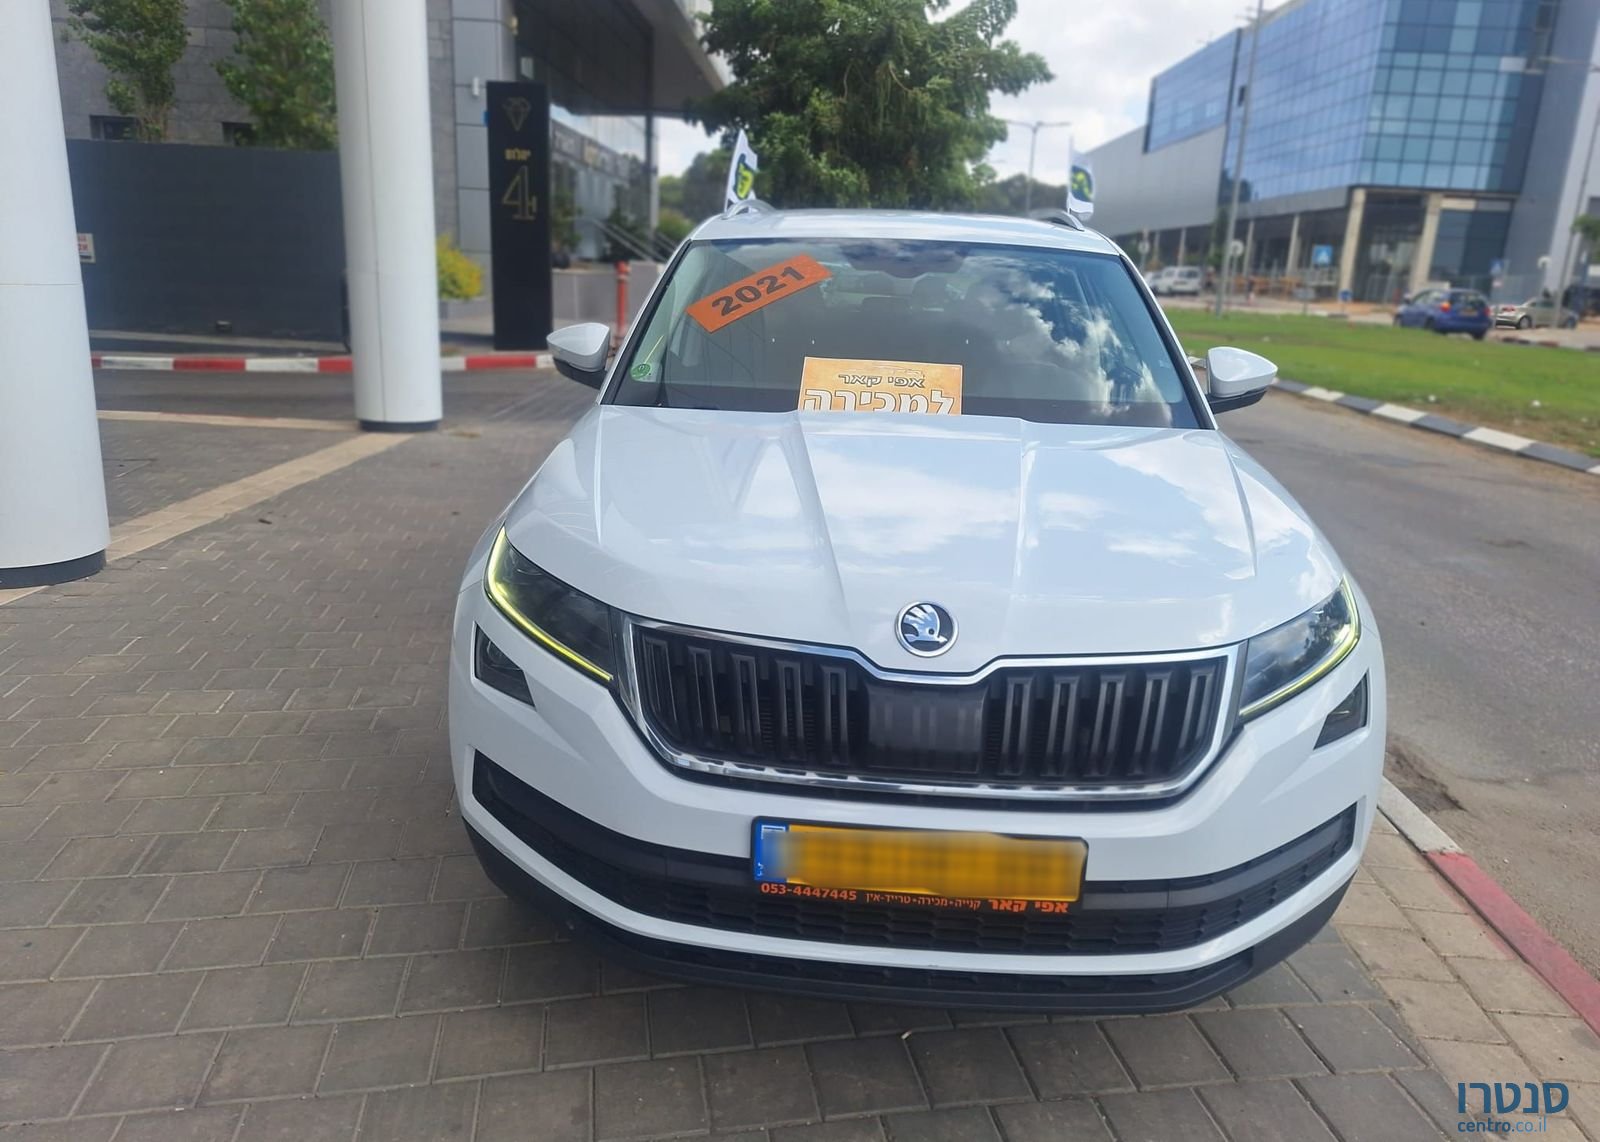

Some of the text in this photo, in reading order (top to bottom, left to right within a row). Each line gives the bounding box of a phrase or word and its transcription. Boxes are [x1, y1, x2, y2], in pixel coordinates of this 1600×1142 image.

[711, 265, 806, 317] 2021
[838, 373, 926, 388] אפי קאר
[803, 388, 955, 415] למכירה
[760, 882, 857, 901] 053-4447445
[988, 898, 1027, 913] קאר
[1034, 900, 1070, 913] אפי
